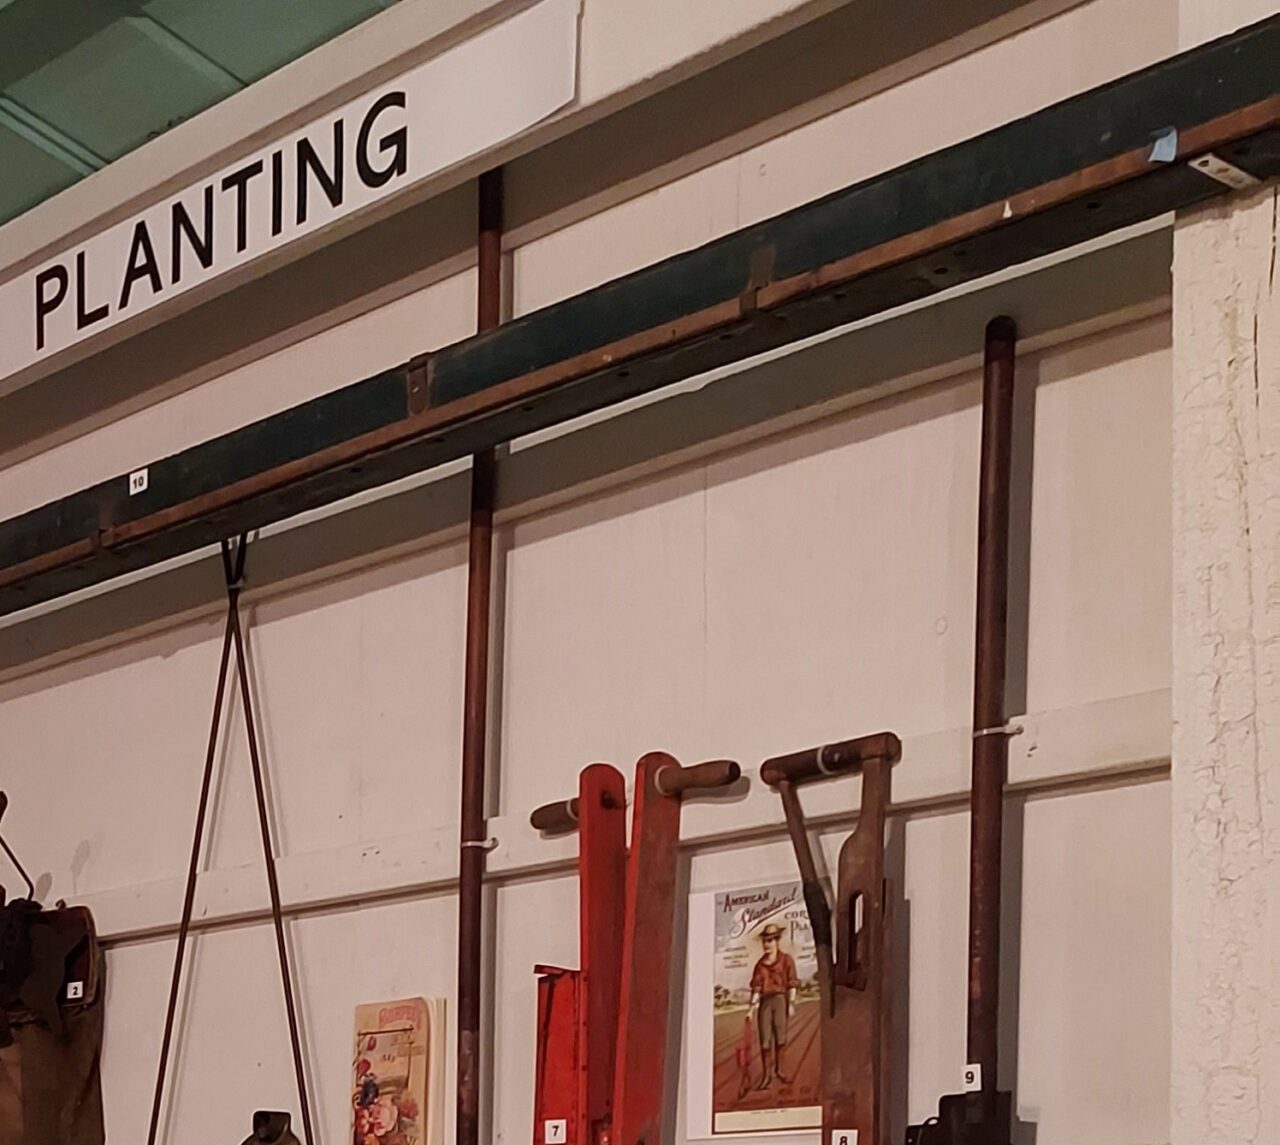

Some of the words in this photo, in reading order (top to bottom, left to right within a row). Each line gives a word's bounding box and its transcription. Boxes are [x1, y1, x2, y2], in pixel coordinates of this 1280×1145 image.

[35, 91, 407, 351] PLANTING
[132, 475, 144, 489] 10
[723, 889, 770, 913] AMERICAN
[784, 909, 809, 920] COR
[964, 1070, 975, 1084] 9
[551, 1124, 560, 1137] 7
